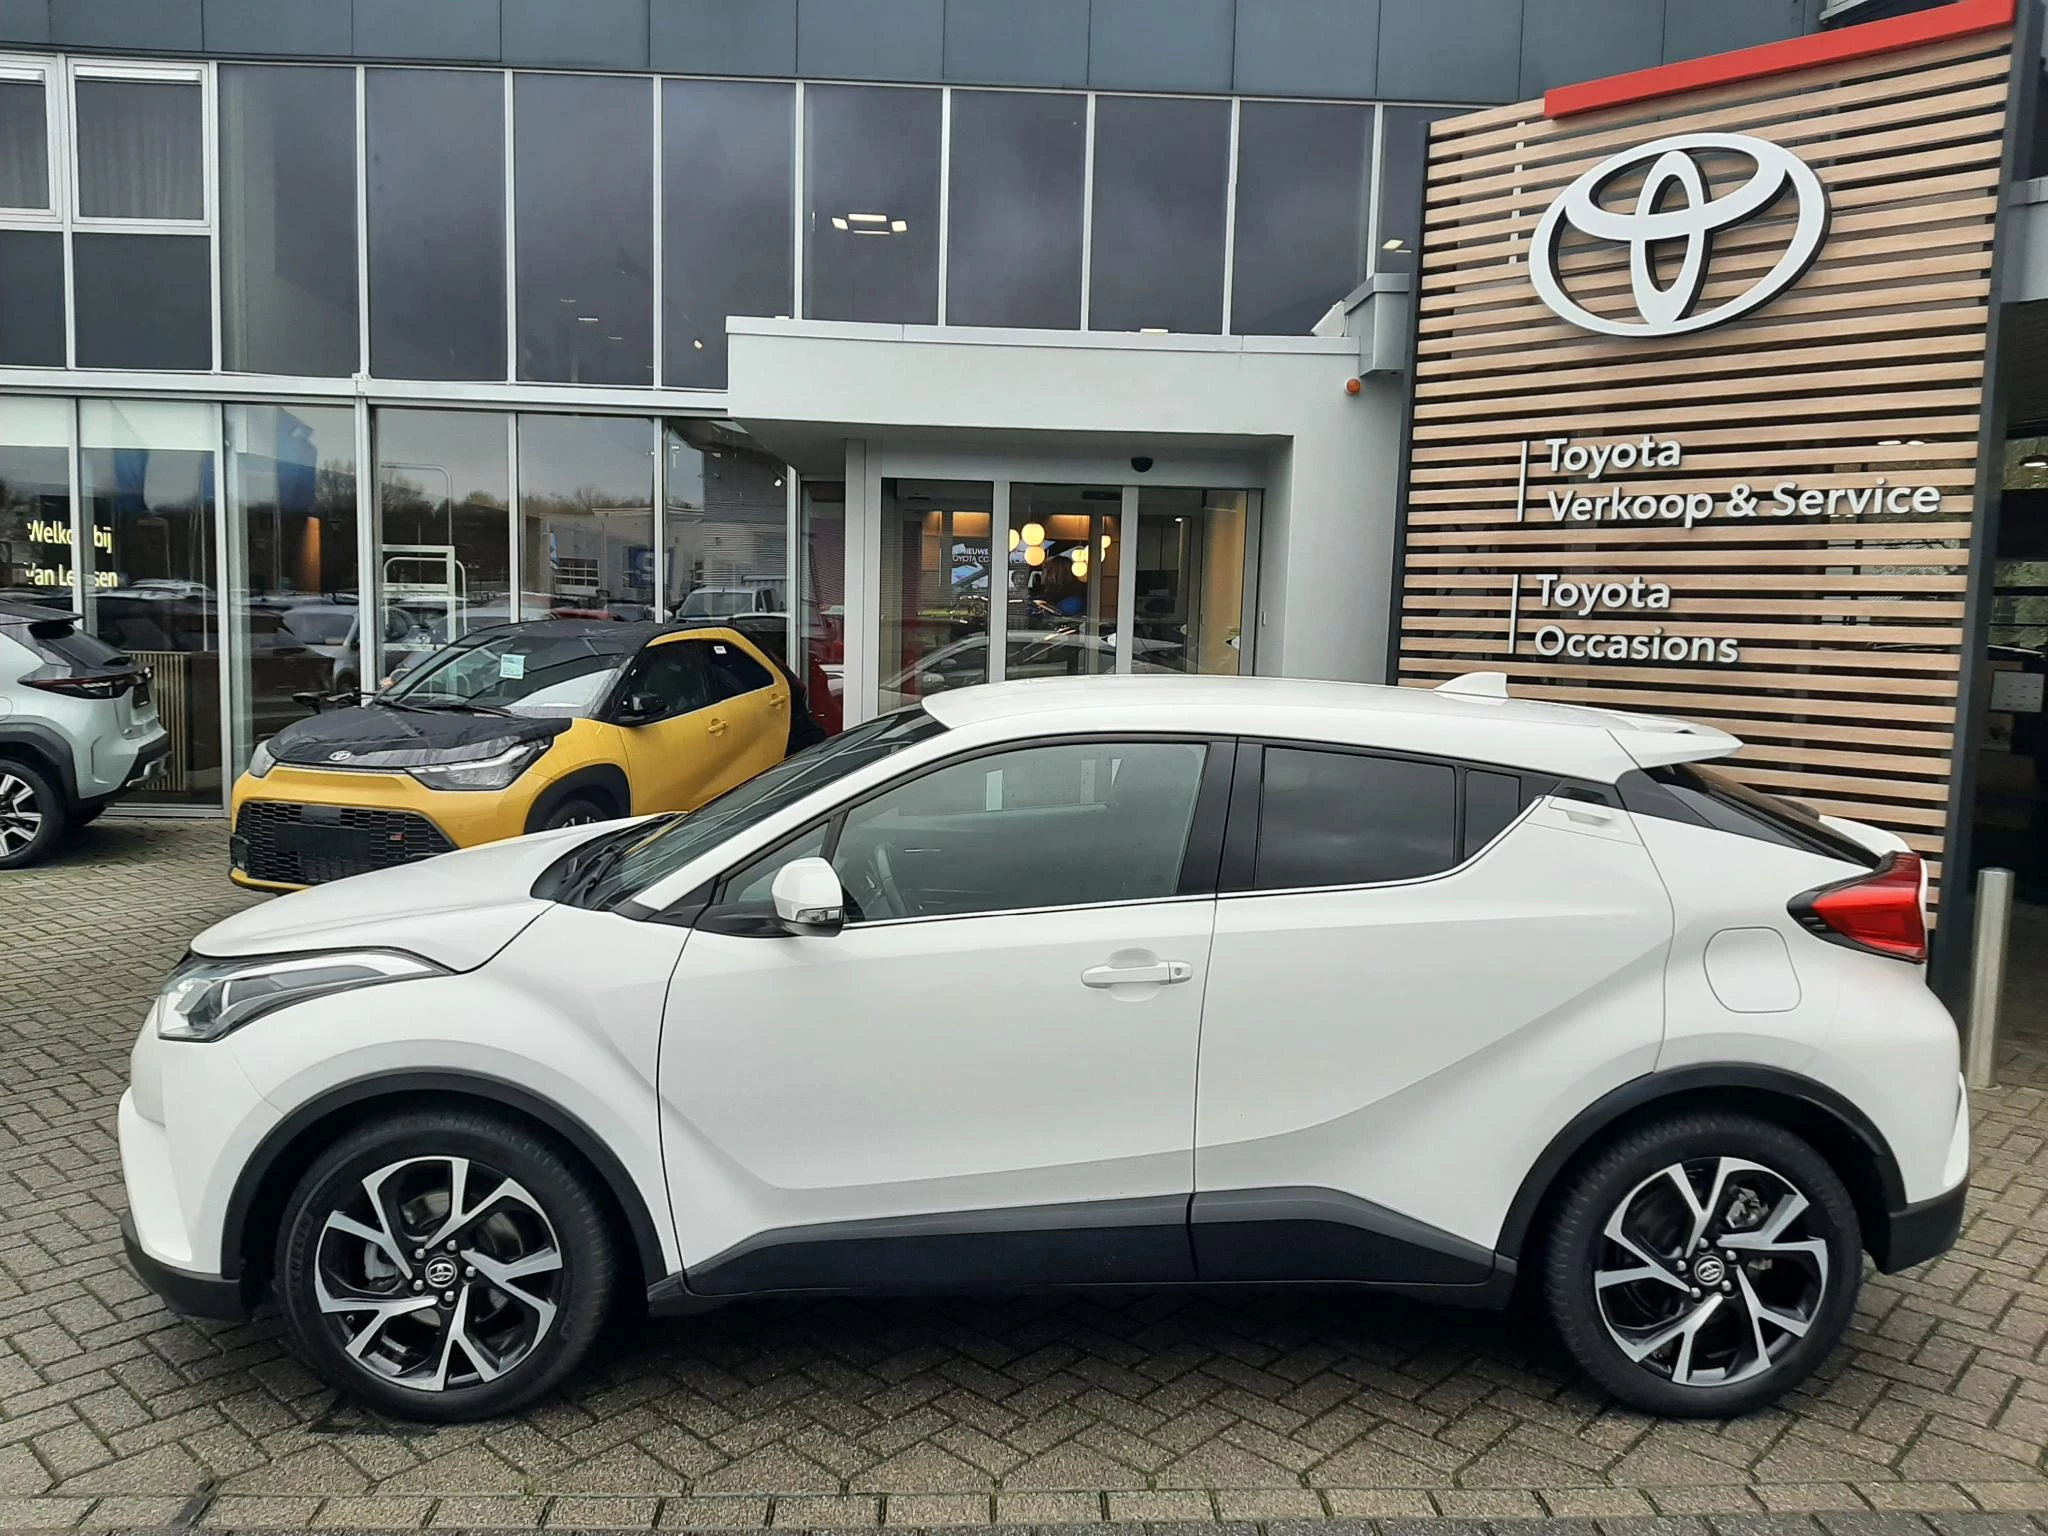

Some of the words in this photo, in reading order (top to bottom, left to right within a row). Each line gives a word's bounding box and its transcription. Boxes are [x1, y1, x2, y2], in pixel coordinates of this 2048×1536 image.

[1545, 435, 1681, 478] Toyota
[1548, 486, 1713, 528] Verkoop
[1726, 483, 1759, 517] &
[1772, 477, 1941, 516] Service
[93, 524, 112, 553] bij
[952, 555, 977, 563] OYOTA
[1536, 574, 1670, 615] Toyota
[1535, 626, 1739, 662] Occasions
